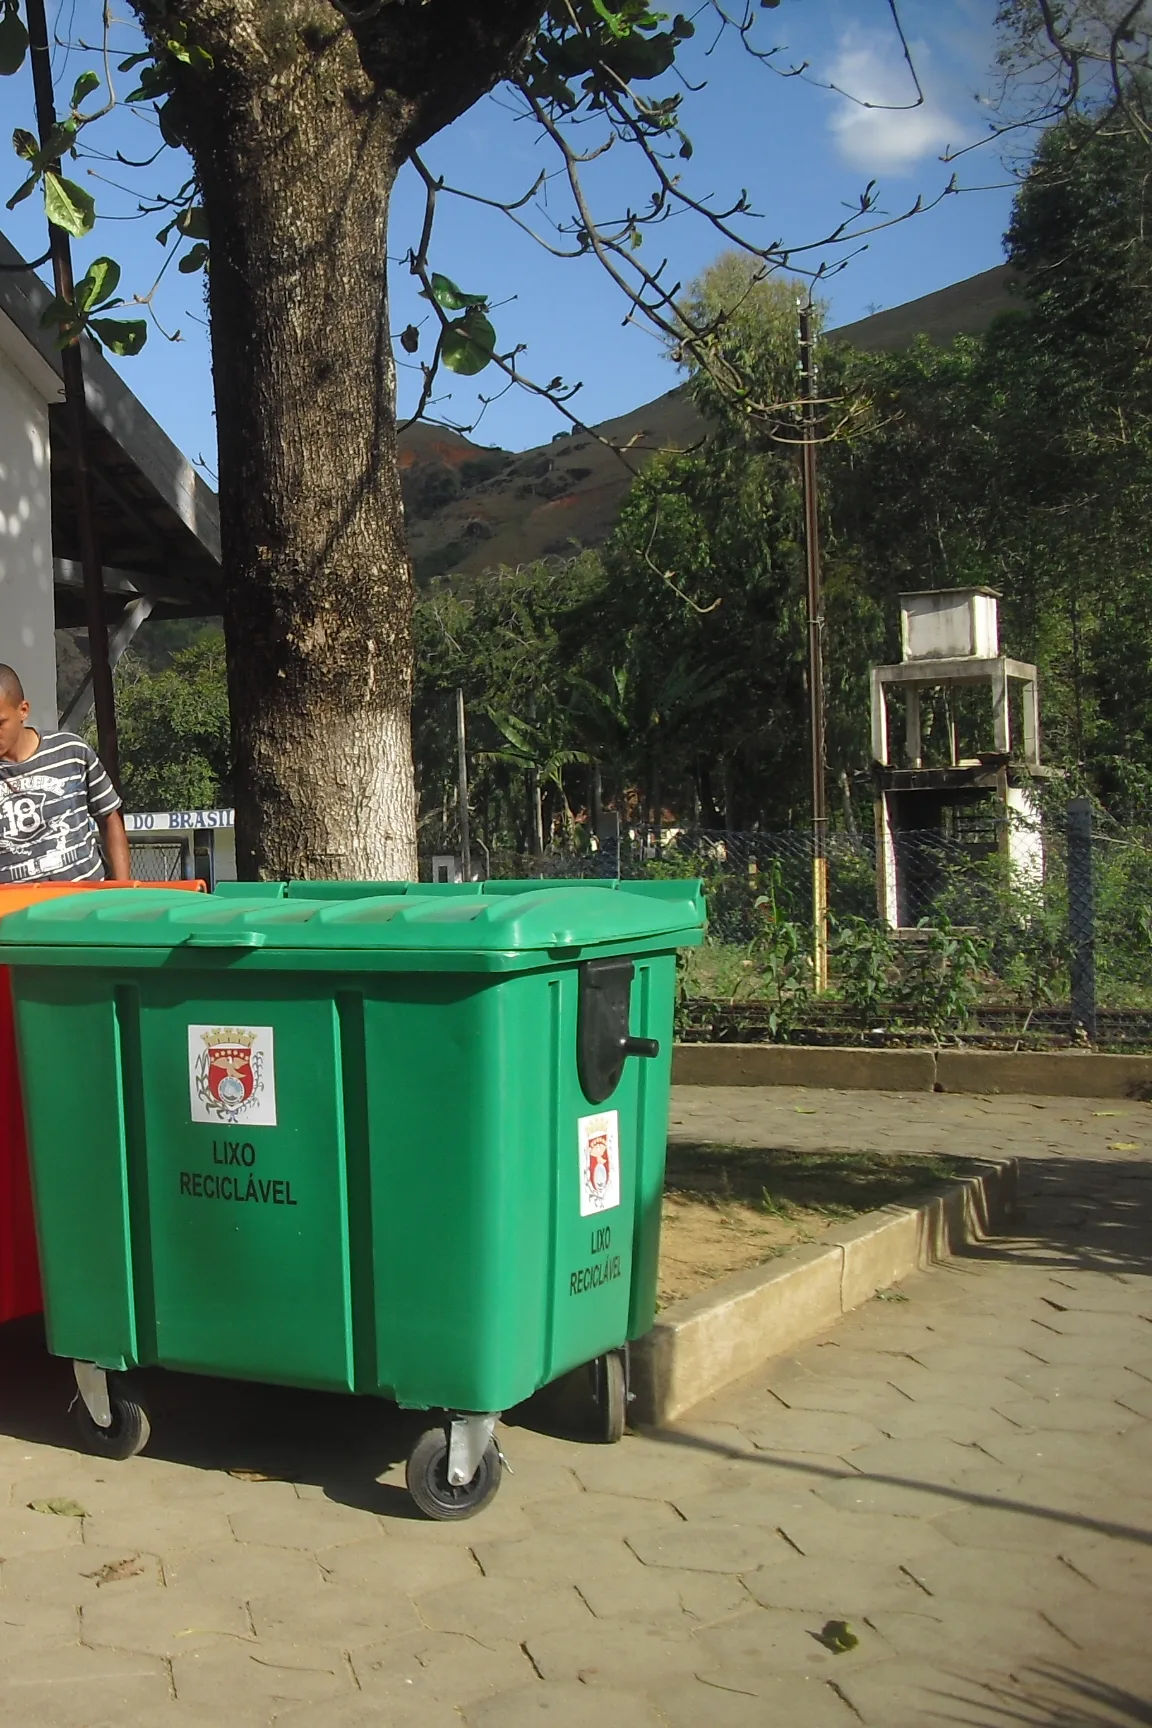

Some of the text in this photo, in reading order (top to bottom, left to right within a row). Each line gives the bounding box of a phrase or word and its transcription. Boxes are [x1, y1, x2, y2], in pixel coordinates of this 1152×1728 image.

[2, 798, 41, 836] 18
[133, 810, 235, 829] DO BRASIL
[212, 1140, 256, 1167] LIXO
[179, 1171, 298, 1206] RECICLÁVEL
[590, 1226, 611, 1255] LIXO
[569, 1255, 622, 1297] RECICLÁVEL
